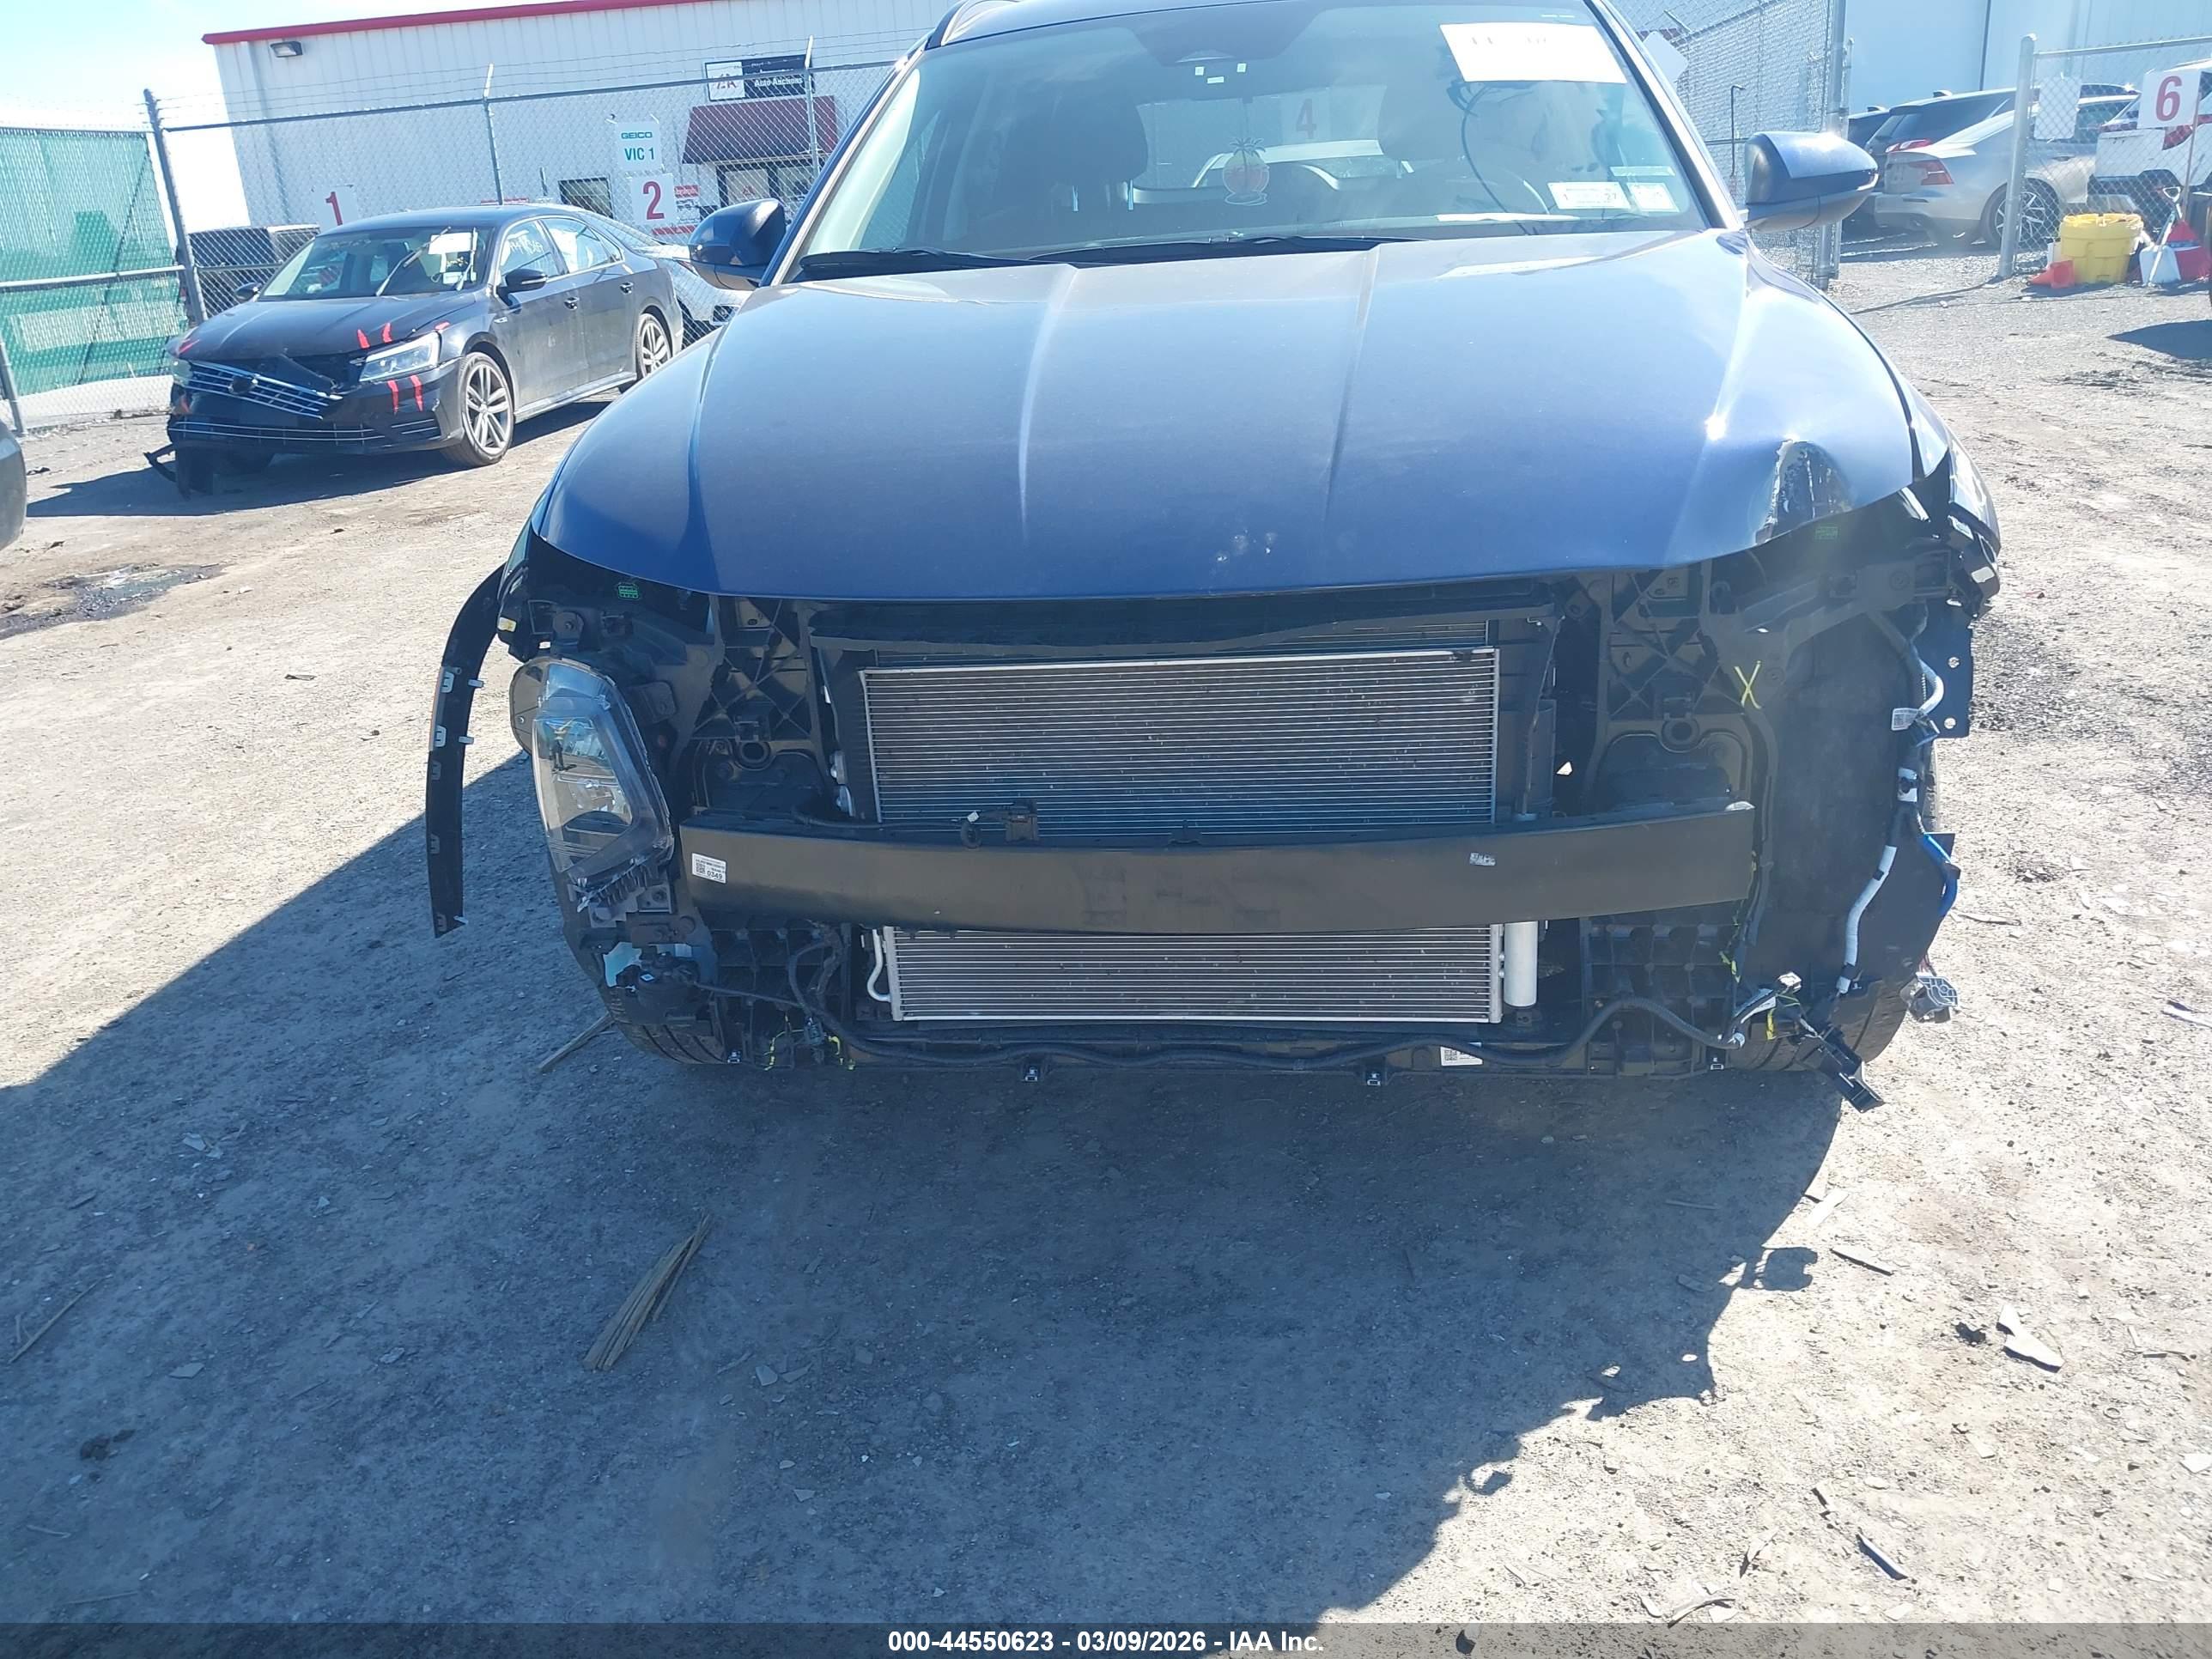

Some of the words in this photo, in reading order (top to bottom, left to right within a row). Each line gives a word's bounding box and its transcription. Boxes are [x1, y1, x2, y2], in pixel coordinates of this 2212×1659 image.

[2155, 76, 2182, 122] 6
[1296, 98, 1317, 139] 4
[624, 148, 645, 161] VIC
[648, 147, 654, 160] 1
[325, 191, 343, 225] 1
[642, 180, 665, 220] 2
[707, 870, 723, 879] 0349
